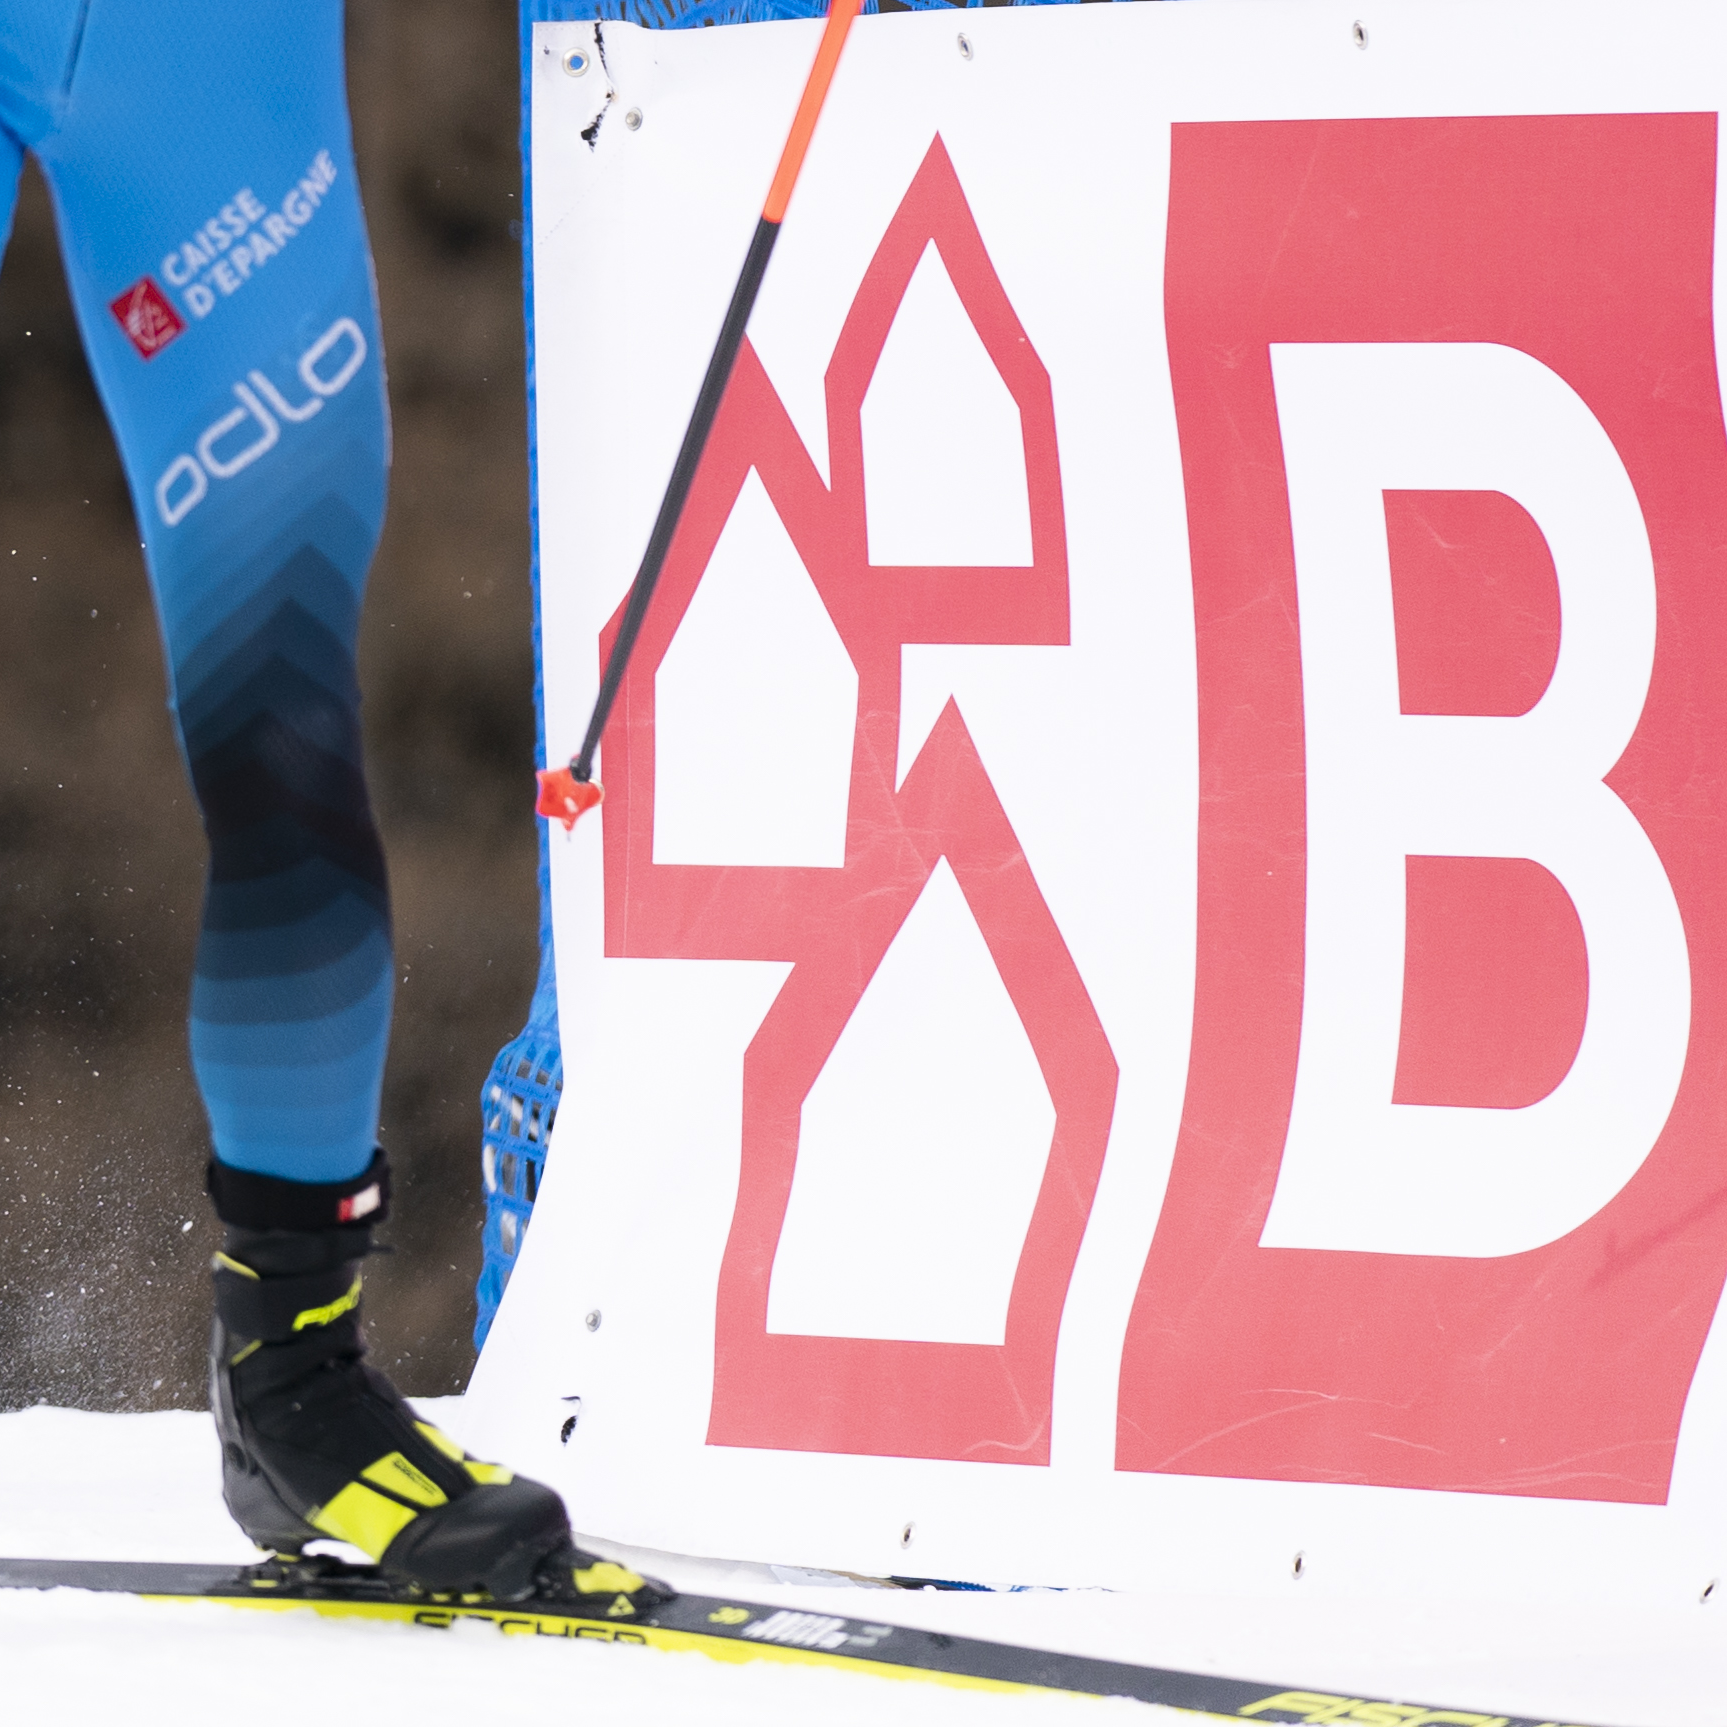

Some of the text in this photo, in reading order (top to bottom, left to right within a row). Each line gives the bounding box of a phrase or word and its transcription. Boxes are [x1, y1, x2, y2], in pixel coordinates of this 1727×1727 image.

[161, 188, 266, 286] CAISSE
[182, 148, 339, 319] D'EPARGNE
[154, 317, 367, 528] odlo
[1258, 340, 1692, 1259] B
